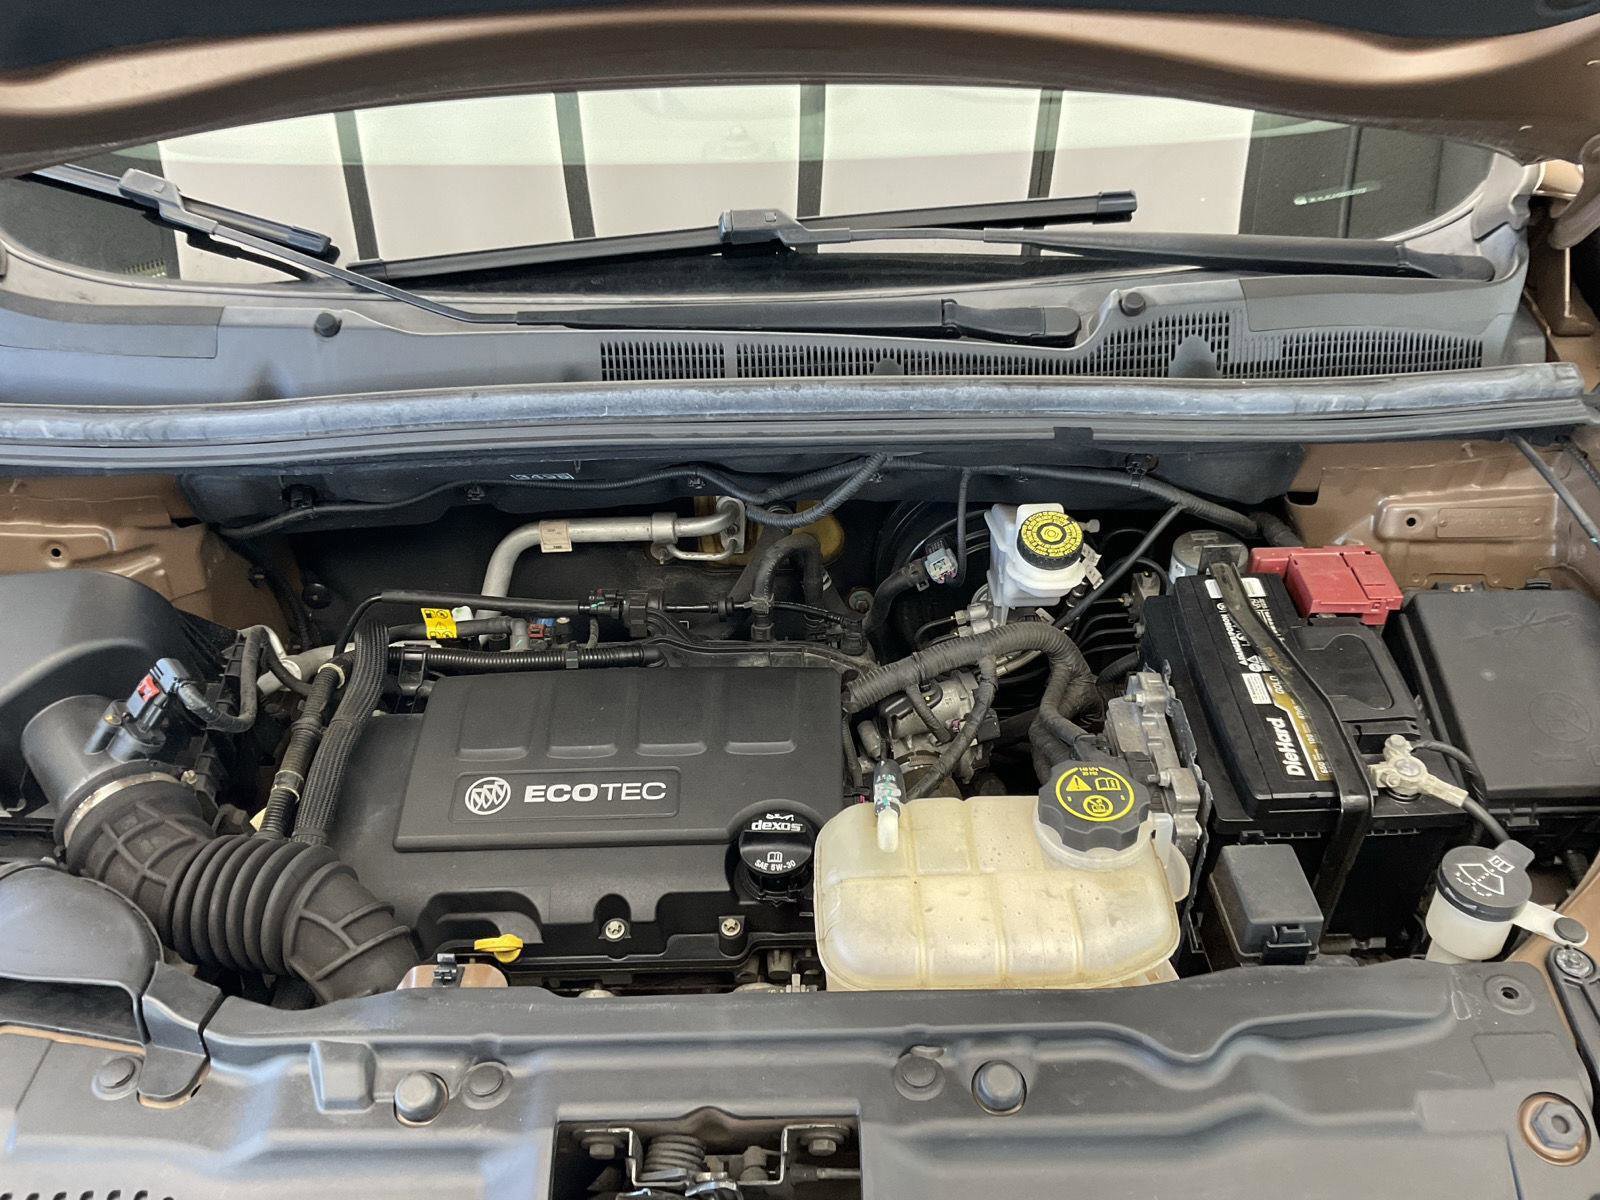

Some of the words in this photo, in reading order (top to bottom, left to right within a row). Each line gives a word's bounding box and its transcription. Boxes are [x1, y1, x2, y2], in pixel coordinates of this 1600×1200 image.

[1266, 717, 1306, 776] DieHard
[523, 781, 667, 803] ECOTEC
[751, 819, 801, 831] dexos
[754, 859, 769, 870] SAE
[771, 859, 796, 871] 5W-30
